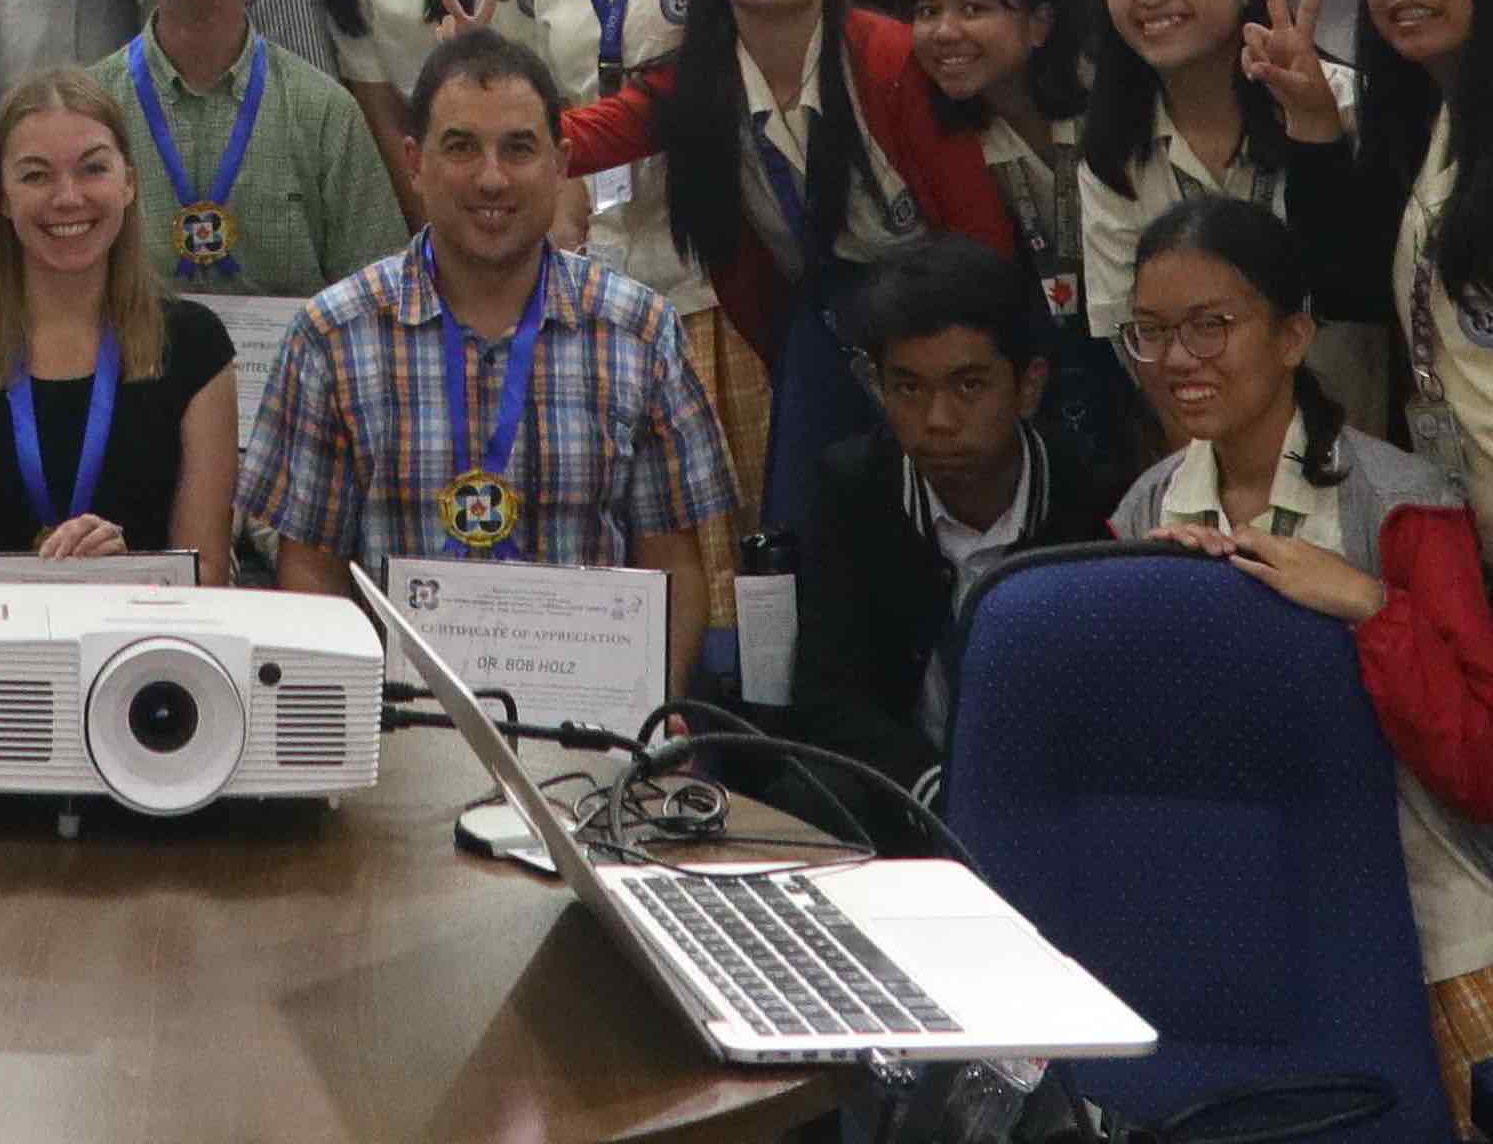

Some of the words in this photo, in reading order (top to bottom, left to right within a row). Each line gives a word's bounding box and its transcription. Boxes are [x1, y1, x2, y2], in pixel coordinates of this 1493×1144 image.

[420, 622, 509, 639] CERTIFICATE
[512, 629, 529, 639] OF
[533, 631, 634, 646] APPRECIATION
[504, 657, 534, 672] BOB
[538, 659, 576, 675] HOLZ
